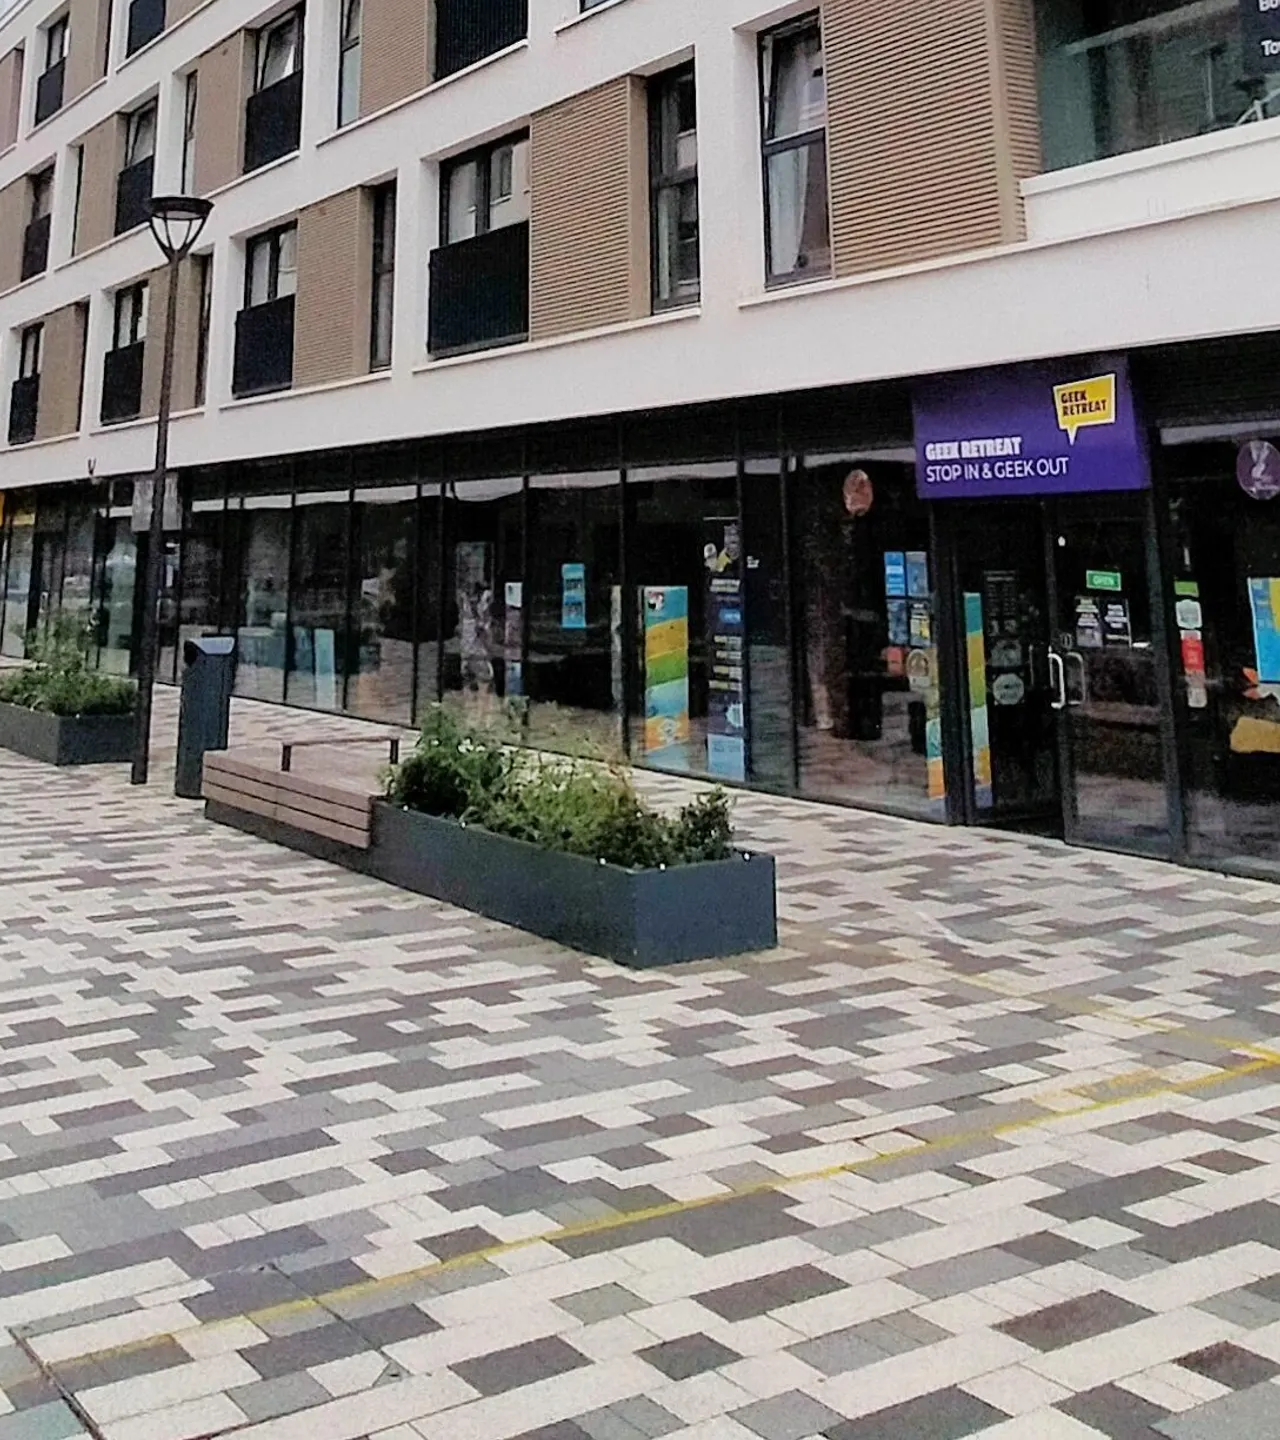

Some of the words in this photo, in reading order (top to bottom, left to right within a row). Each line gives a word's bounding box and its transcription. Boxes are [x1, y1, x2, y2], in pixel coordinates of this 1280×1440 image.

[1060, 389, 1087, 404] GEEK
[1062, 399, 1108, 417] RETREAT
[925, 440, 960, 460] GEEK
[961, 436, 1022, 458] RETREAT
[926, 464, 962, 483] STOP
[964, 463, 979, 480] IN
[983, 463, 992, 479] &
[994, 459, 1035, 479] GEEK
[1036, 457, 1069, 476] OUT
